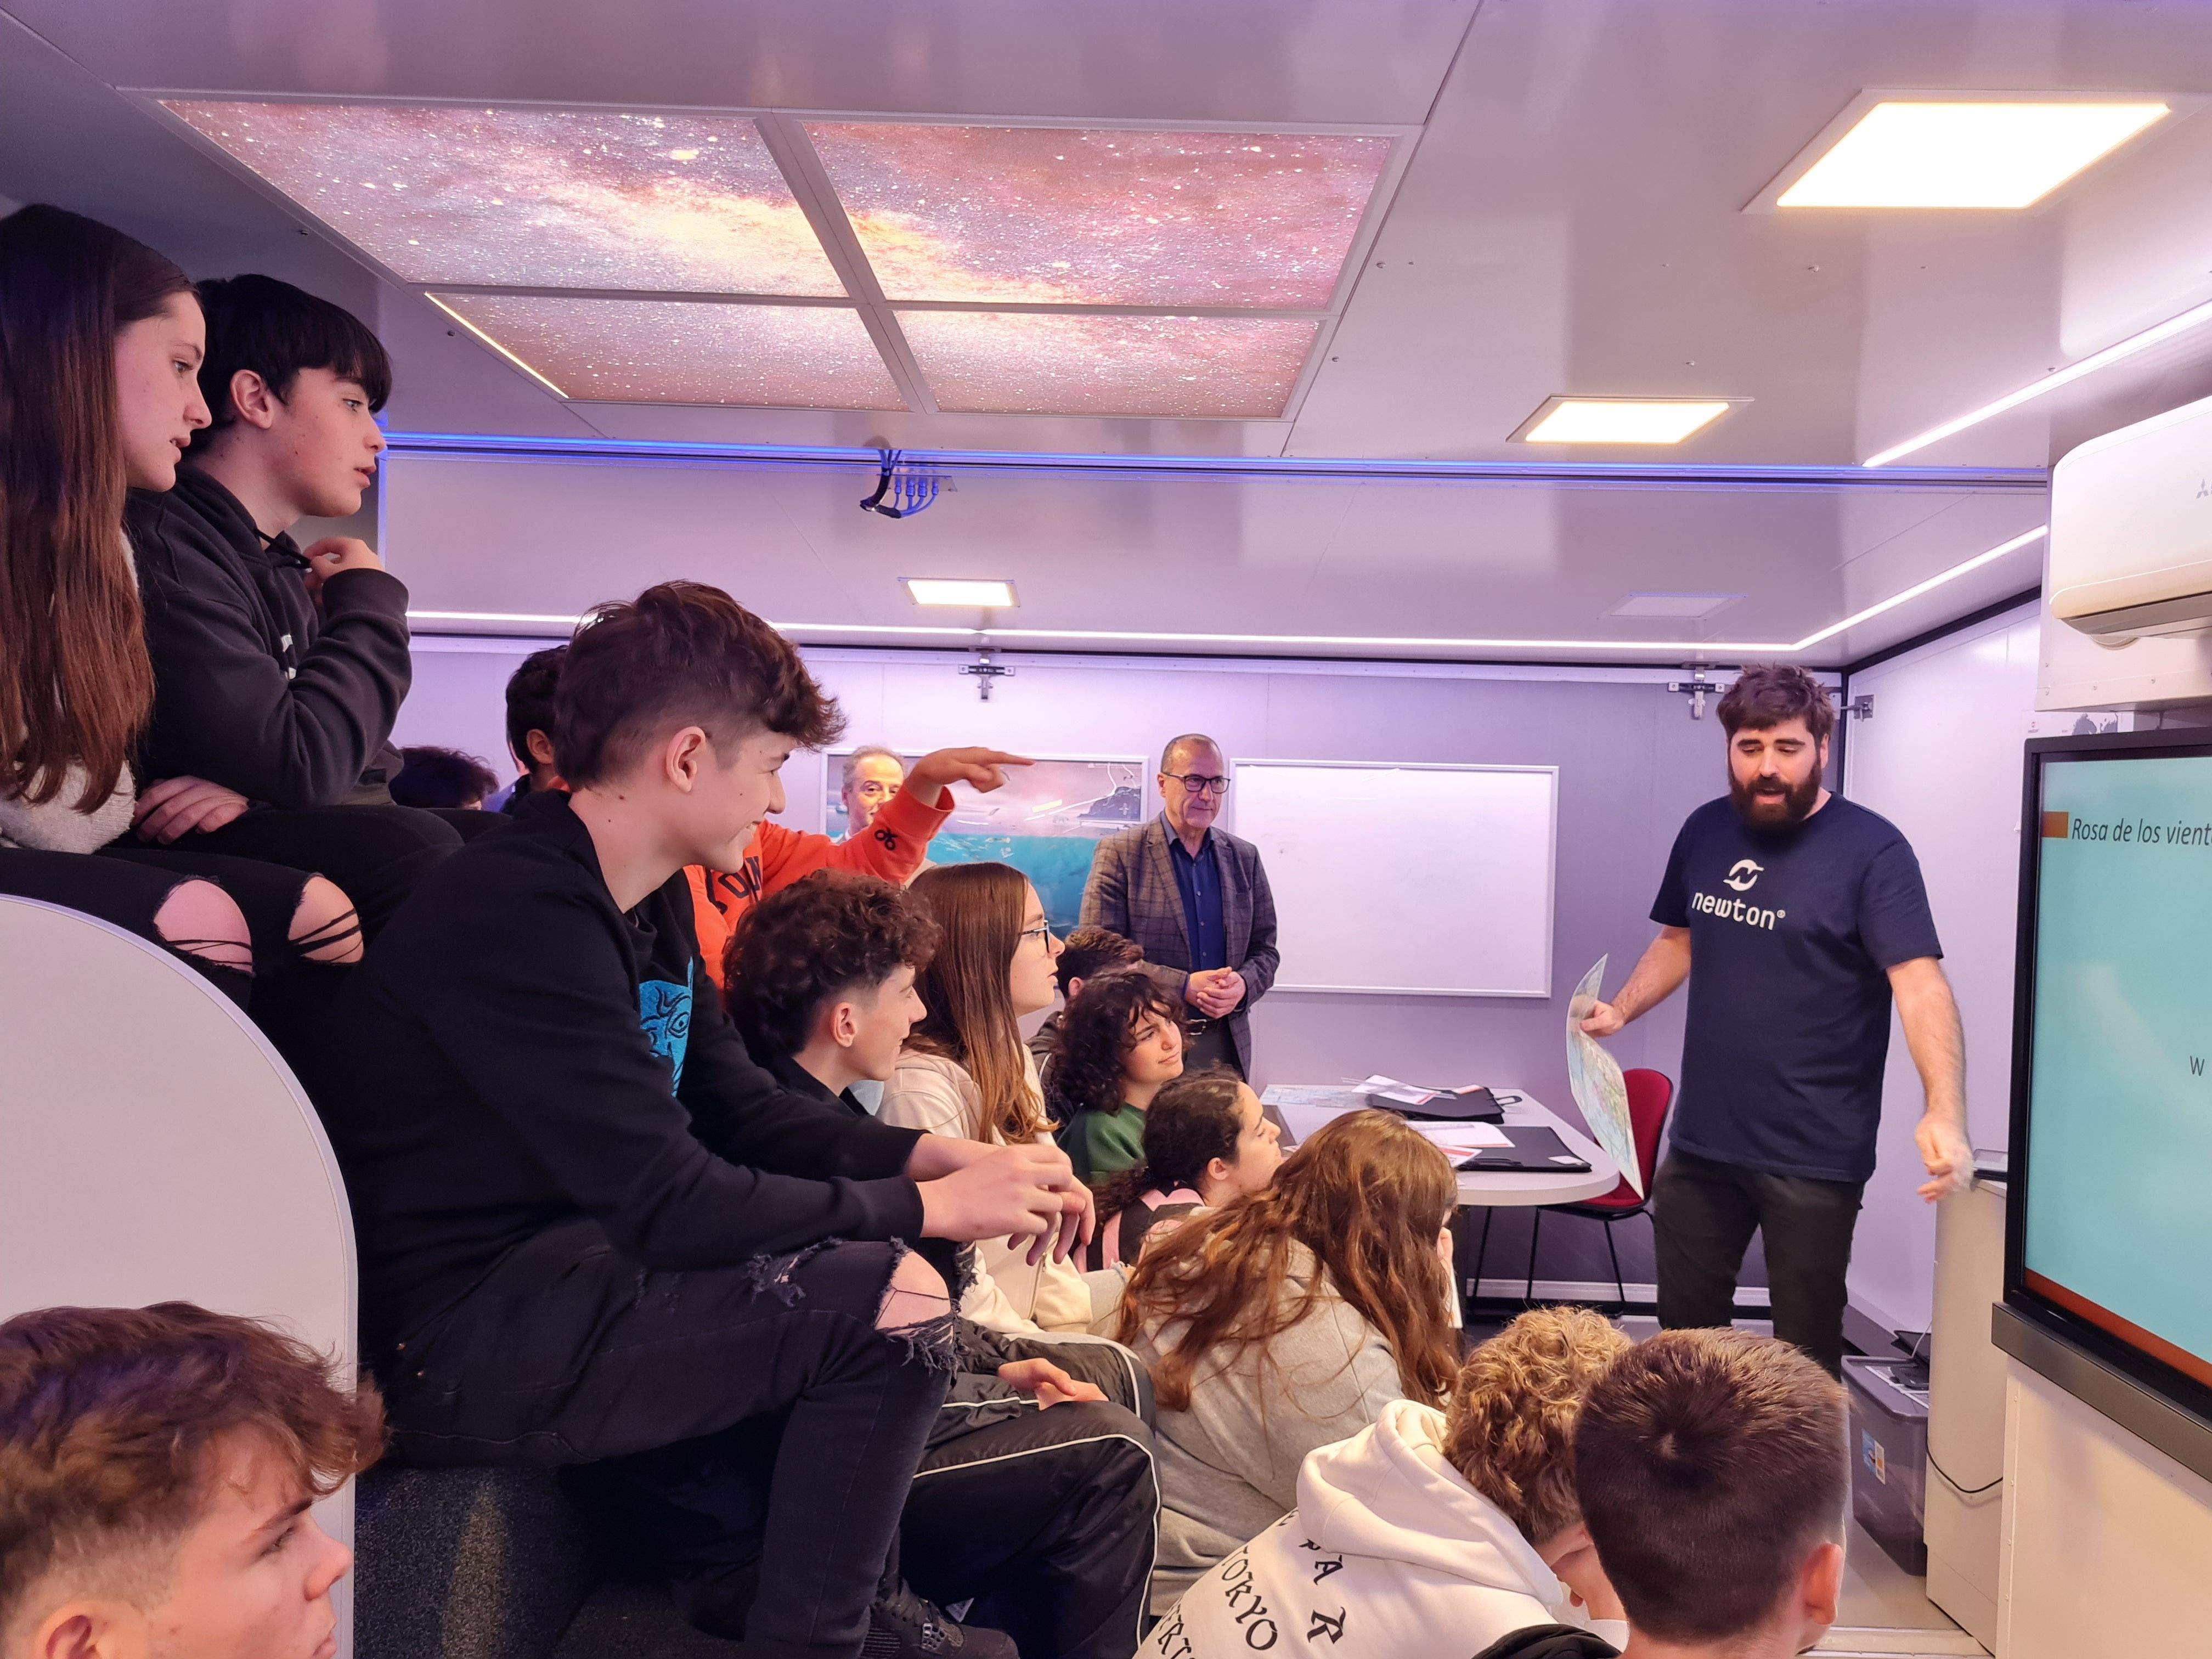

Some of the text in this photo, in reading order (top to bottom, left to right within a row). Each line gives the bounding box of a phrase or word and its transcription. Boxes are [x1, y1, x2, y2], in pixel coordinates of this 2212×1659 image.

[2072, 818, 2212, 846] Rosa de los vient
[2190, 1055, 2205, 1077] W
